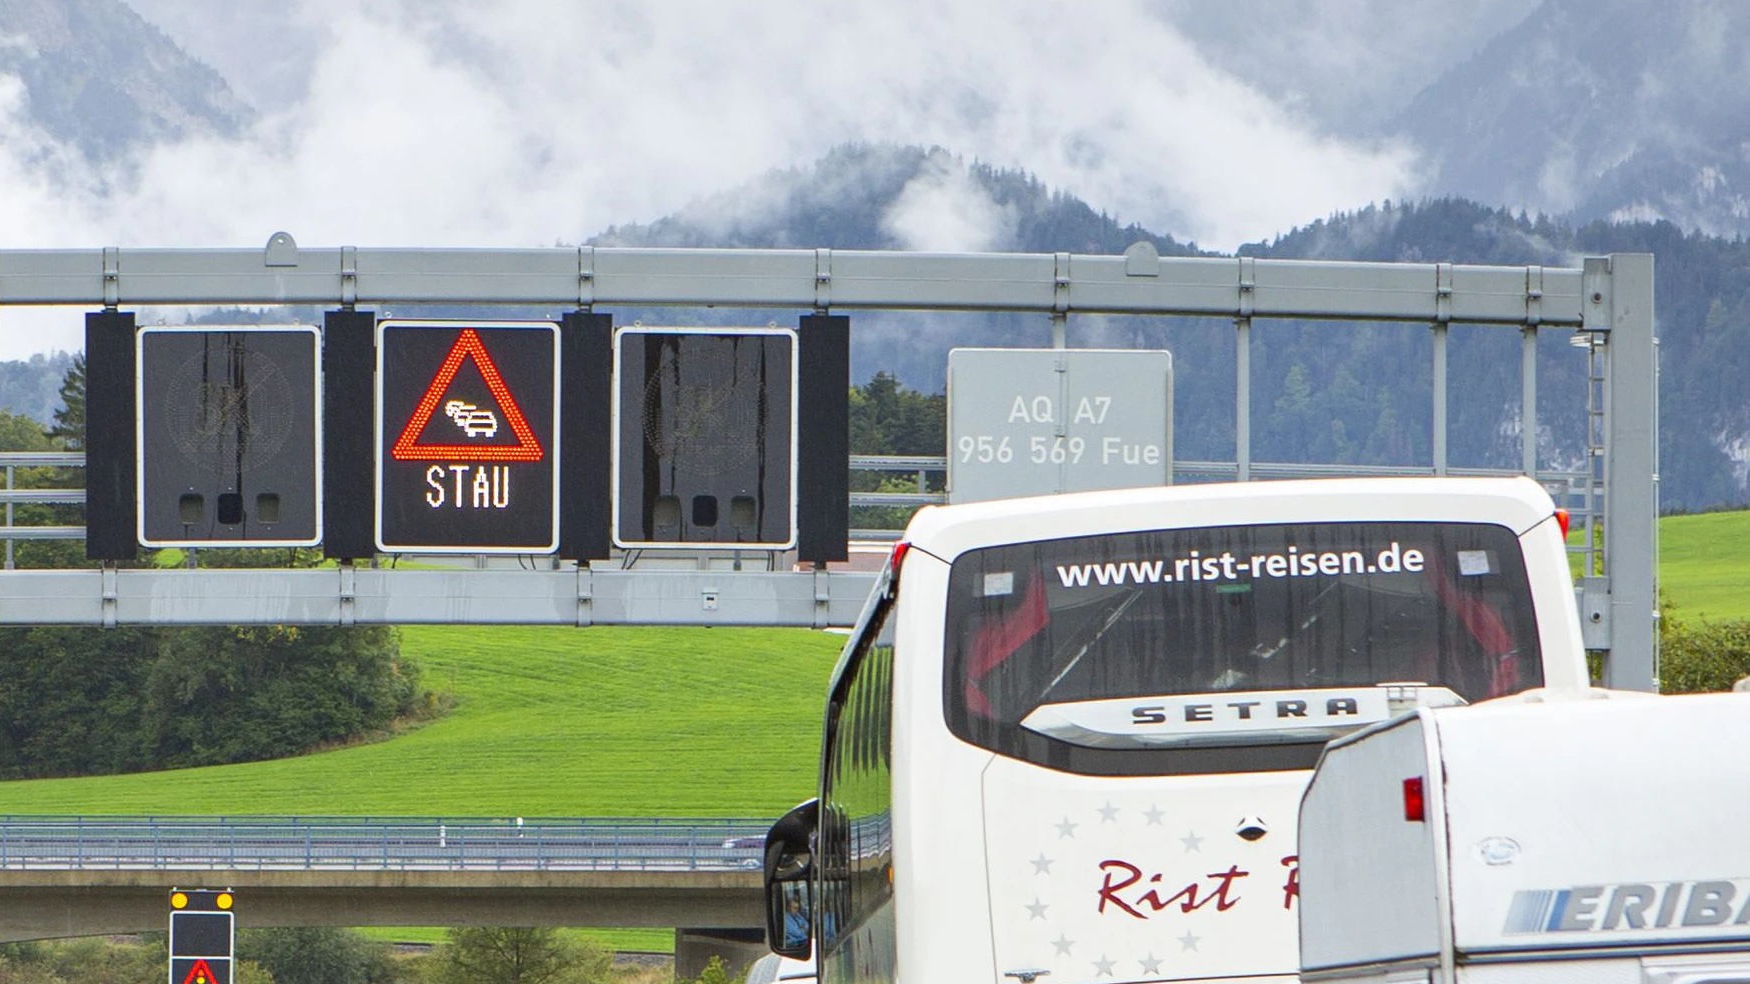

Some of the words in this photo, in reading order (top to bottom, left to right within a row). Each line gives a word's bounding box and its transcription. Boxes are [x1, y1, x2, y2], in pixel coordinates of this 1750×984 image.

[1008, 396, 1054, 423] AQ
[1074, 397, 1112, 424] A7
[958, 436, 1013, 464] 956
[1030, 437, 1086, 464] 569
[1102, 437, 1160, 465] Fue
[426, 465, 509, 508] STAU
[1056, 542, 1424, 587] www.rist-reisen.de
[1132, 697, 1359, 725] SETRA
[1098, 860, 1249, 919] Rist
[1559, 880, 1750, 931] ERIB
